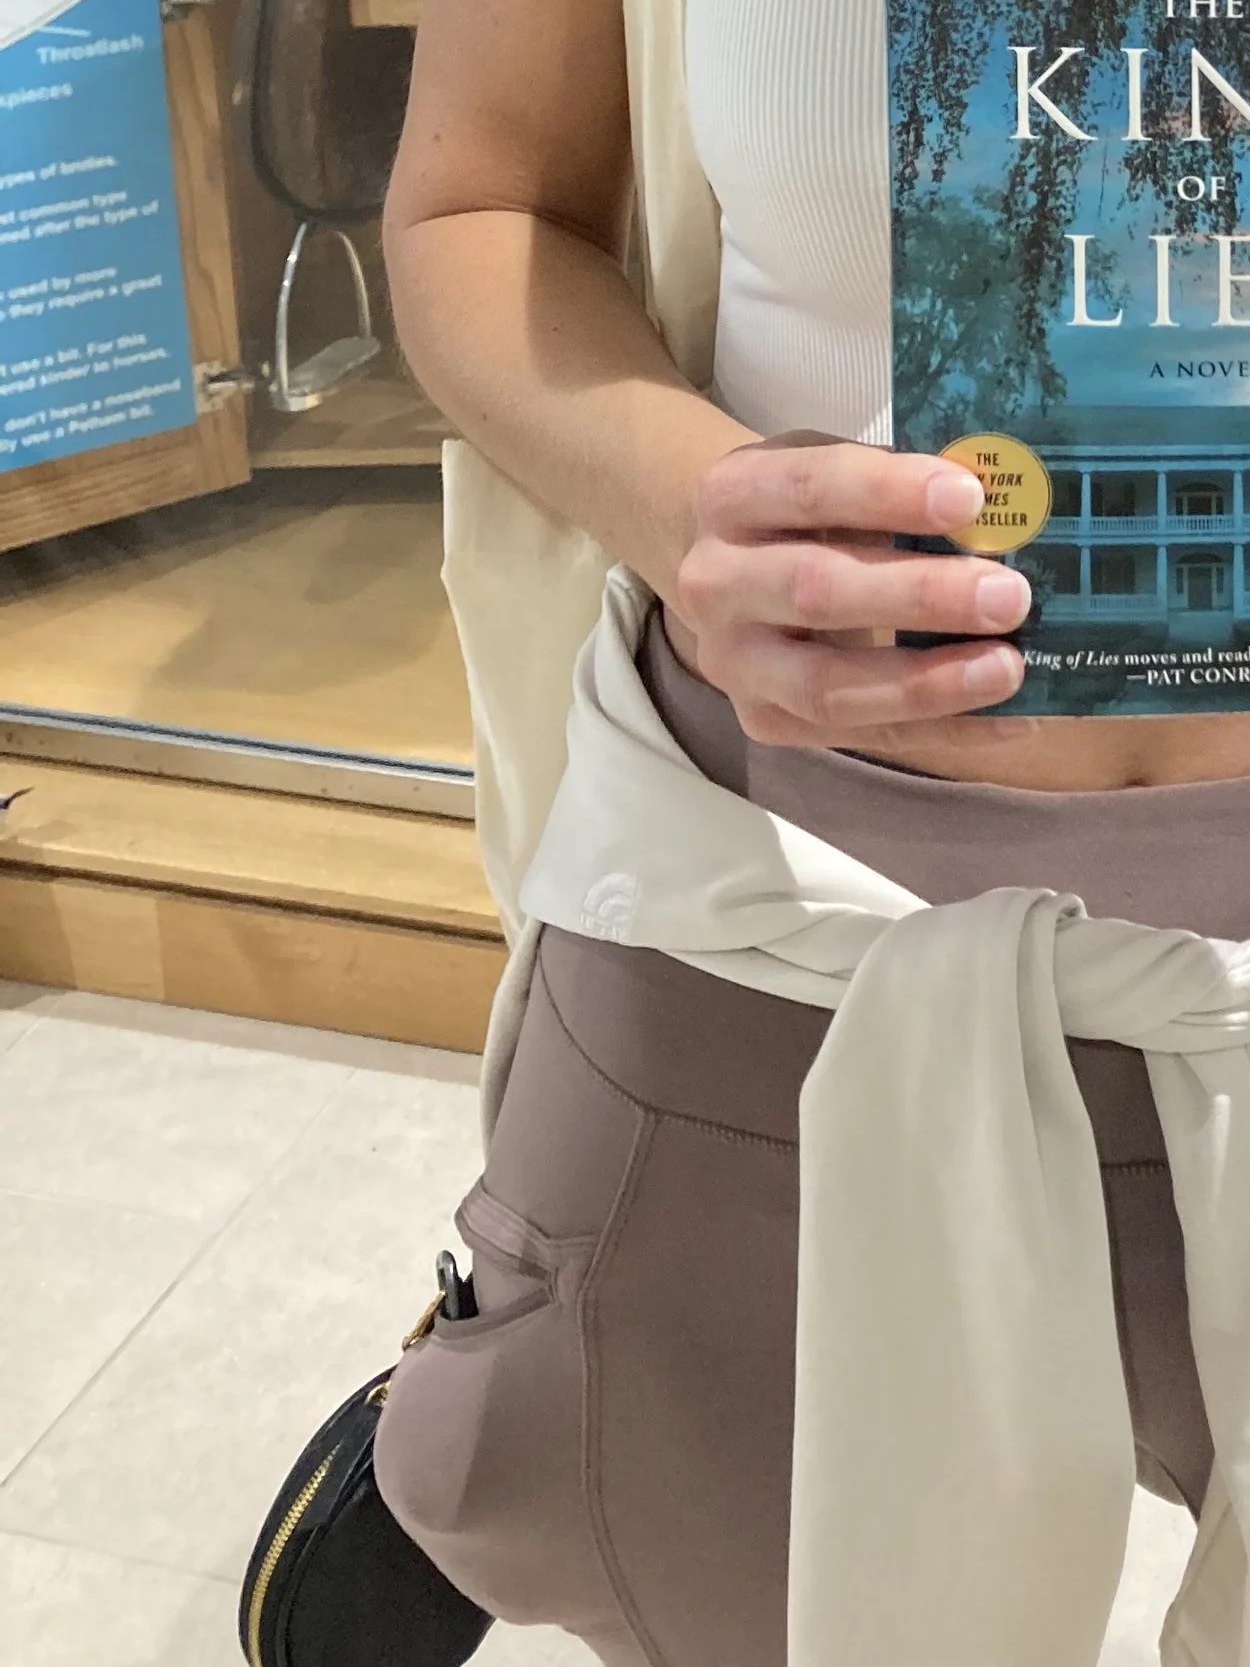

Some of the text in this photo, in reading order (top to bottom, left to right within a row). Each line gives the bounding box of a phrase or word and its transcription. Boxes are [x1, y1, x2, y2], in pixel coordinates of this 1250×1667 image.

[1177, 175, 1227, 202] OF
[1149, 361, 1165, 379] A
[976, 453, 1000, 466] THE
[990, 473, 1023, 487] YORK
[1023, 651, 1060, 670] King
[1065, 650, 1085, 668] of
[1086, 650, 1119, 666] Lies
[1124, 652, 1177, 666] moves
[1182, 647, 1213, 664] and
